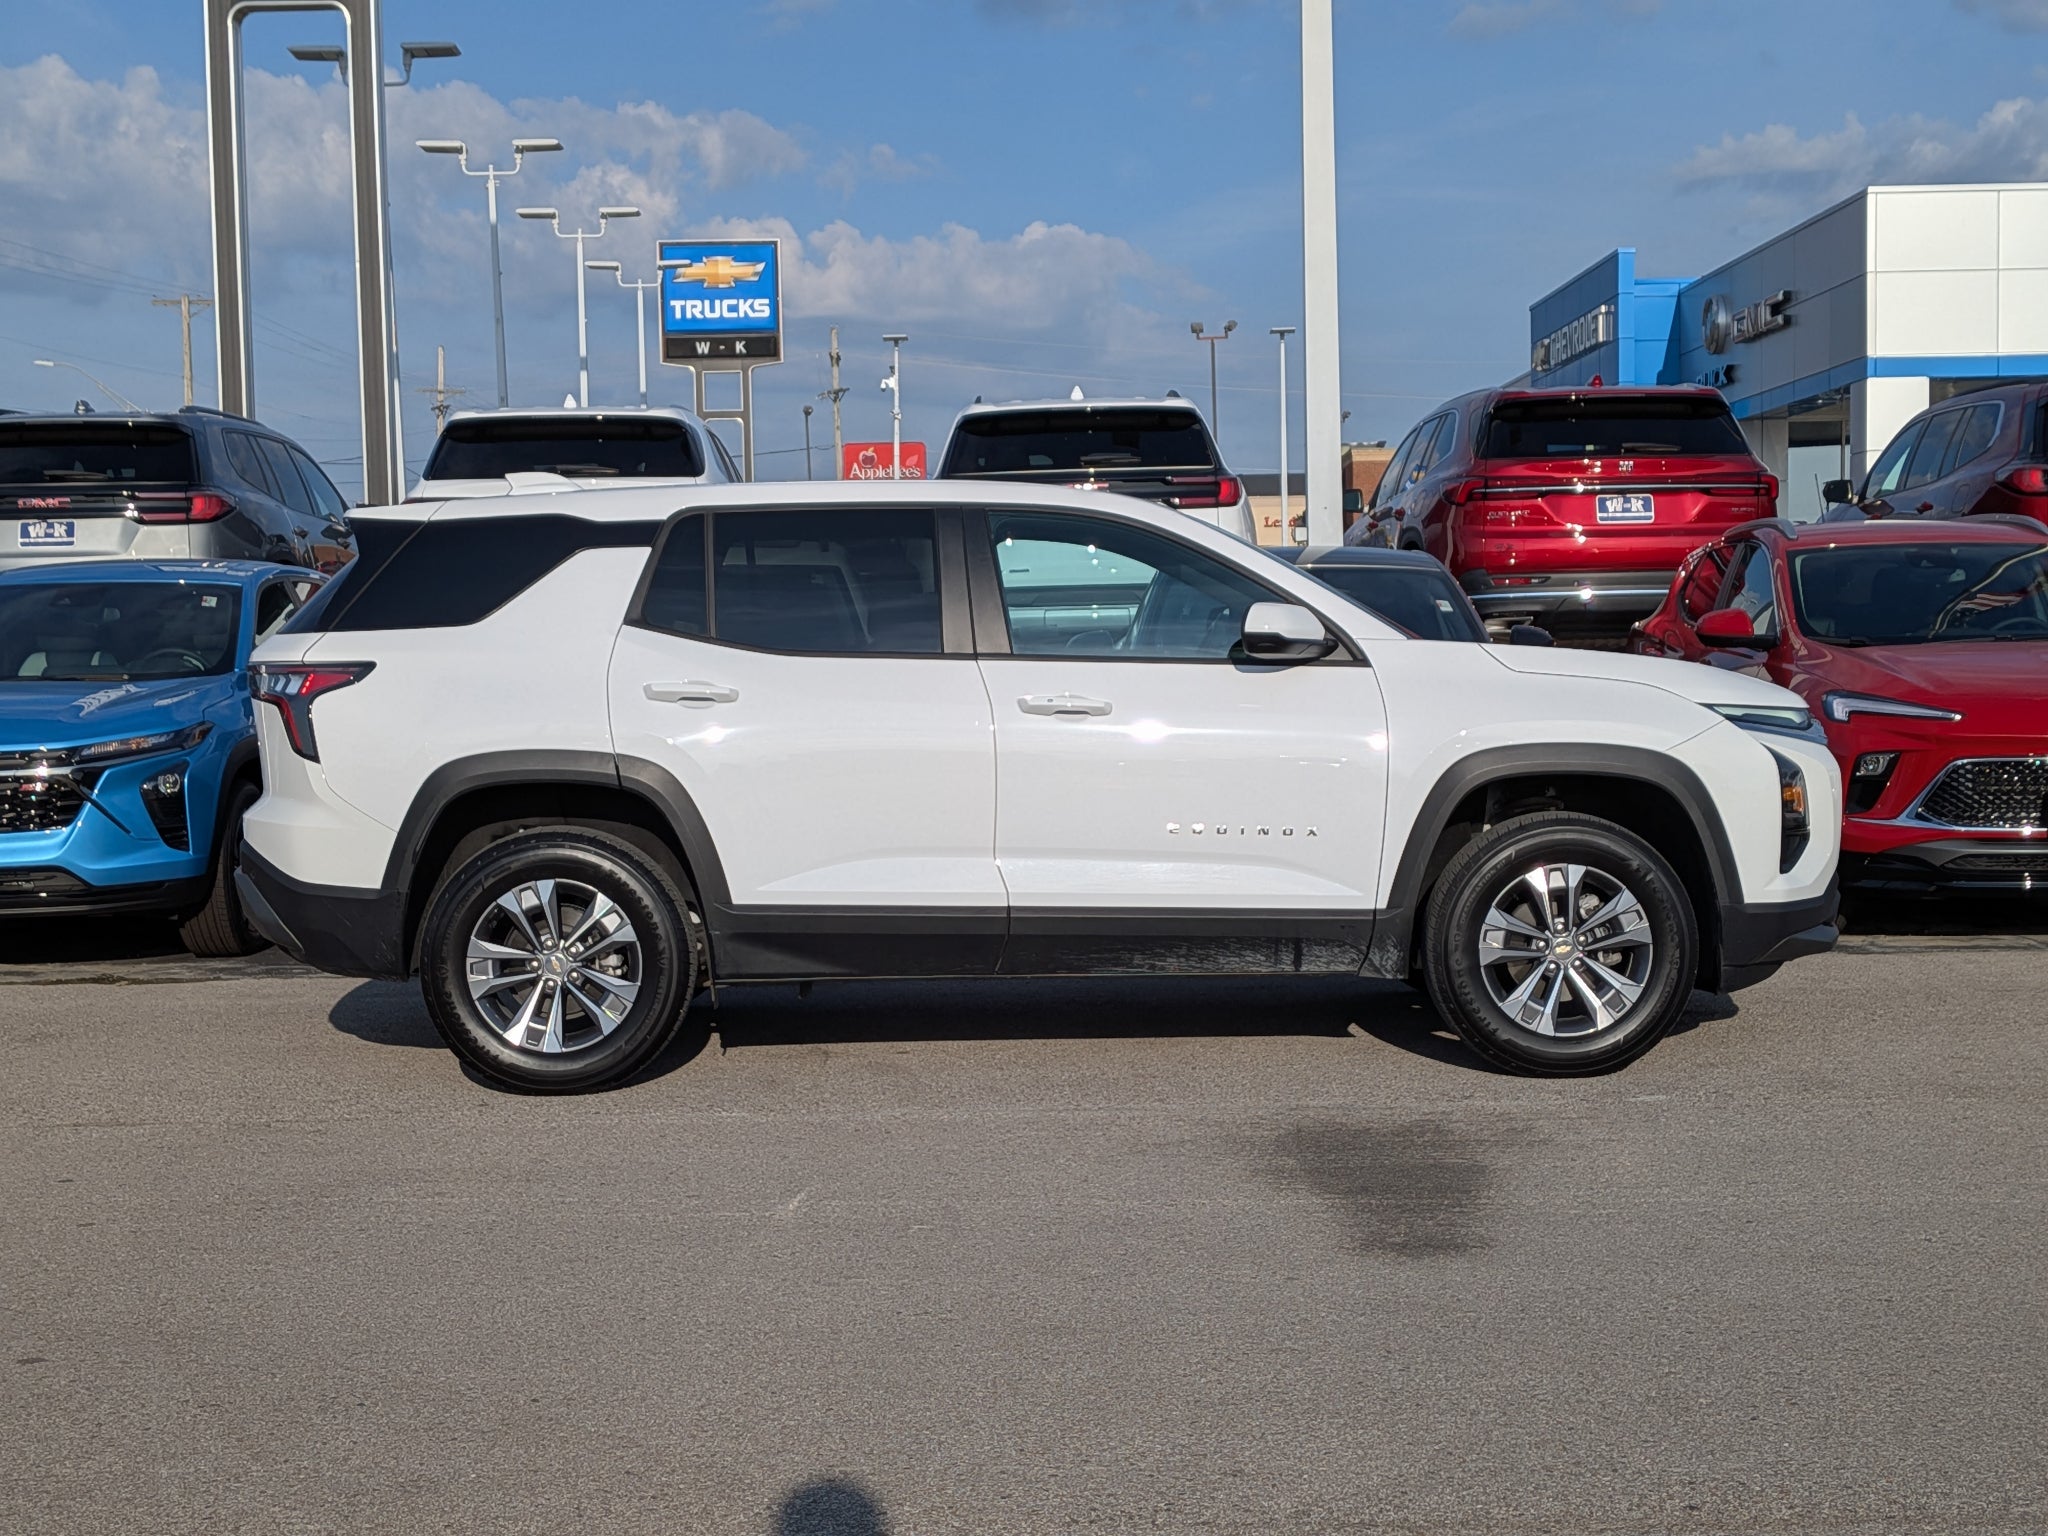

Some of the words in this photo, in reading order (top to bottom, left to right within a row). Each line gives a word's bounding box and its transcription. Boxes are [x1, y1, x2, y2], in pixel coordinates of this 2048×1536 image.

[670, 298, 771, 319] TRUCKS
[1731, 290, 1785, 344] GMC
[1550, 304, 1614, 366] CHEVROLET
[1605, 496, 1645, 513] W-K
[28, 521, 68, 538] W-K
[1166, 822, 1318, 837] EQUINOX
